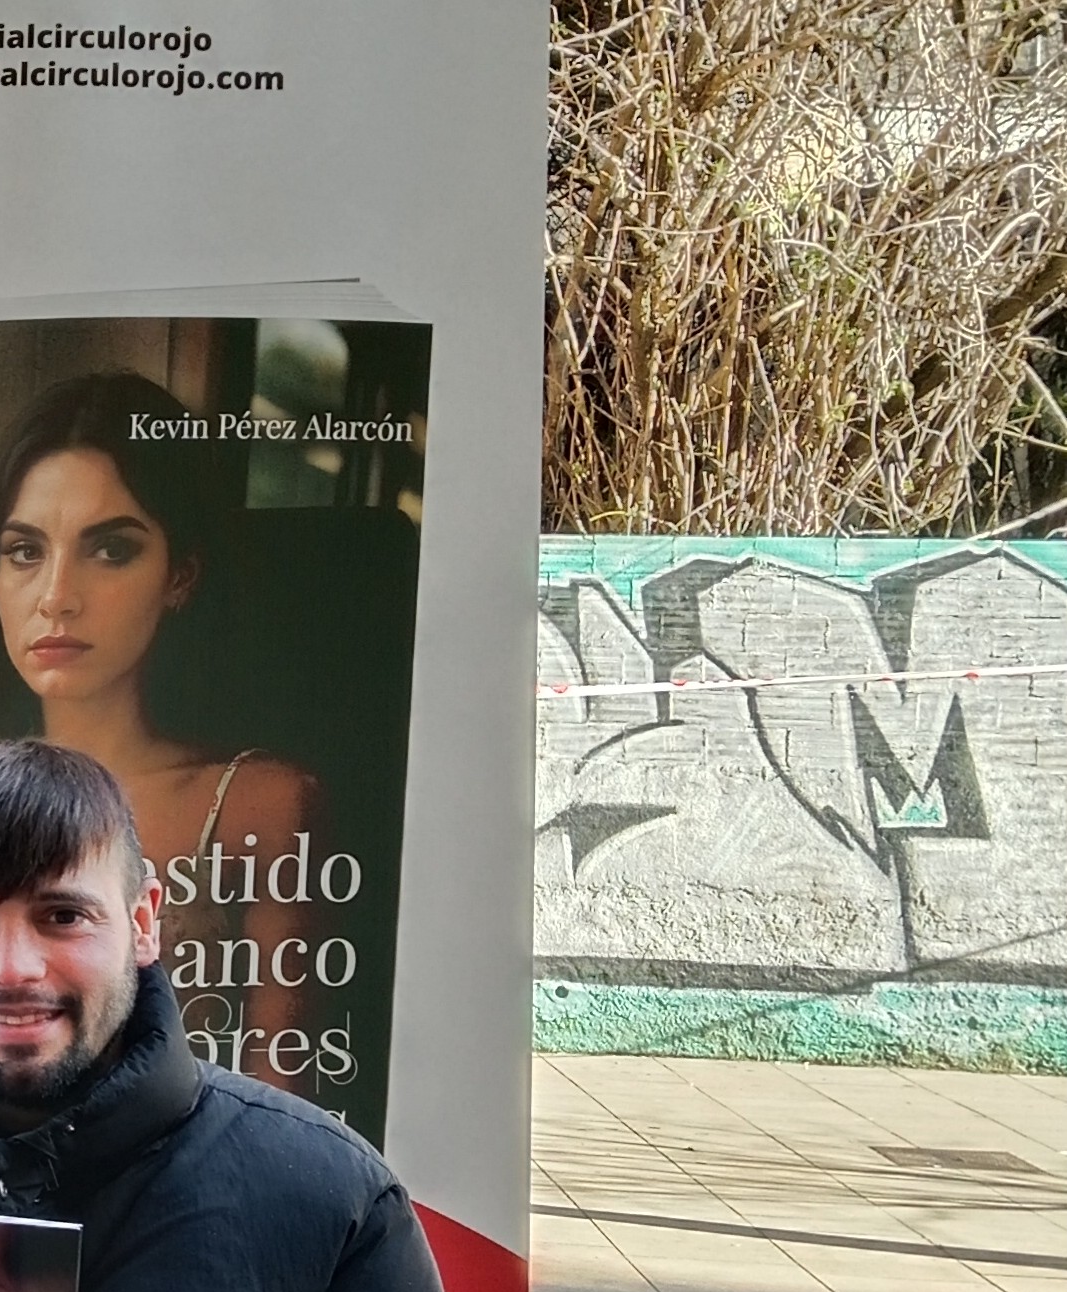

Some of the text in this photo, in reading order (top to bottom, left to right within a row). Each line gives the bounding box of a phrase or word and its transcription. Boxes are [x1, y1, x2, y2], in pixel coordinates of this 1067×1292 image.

[128, 409, 414, 442] Kevin Pérez Alarcón
[141, 831, 362, 905] stido
[155, 920, 357, 988] anco
[182, 1000, 358, 1086] ores
